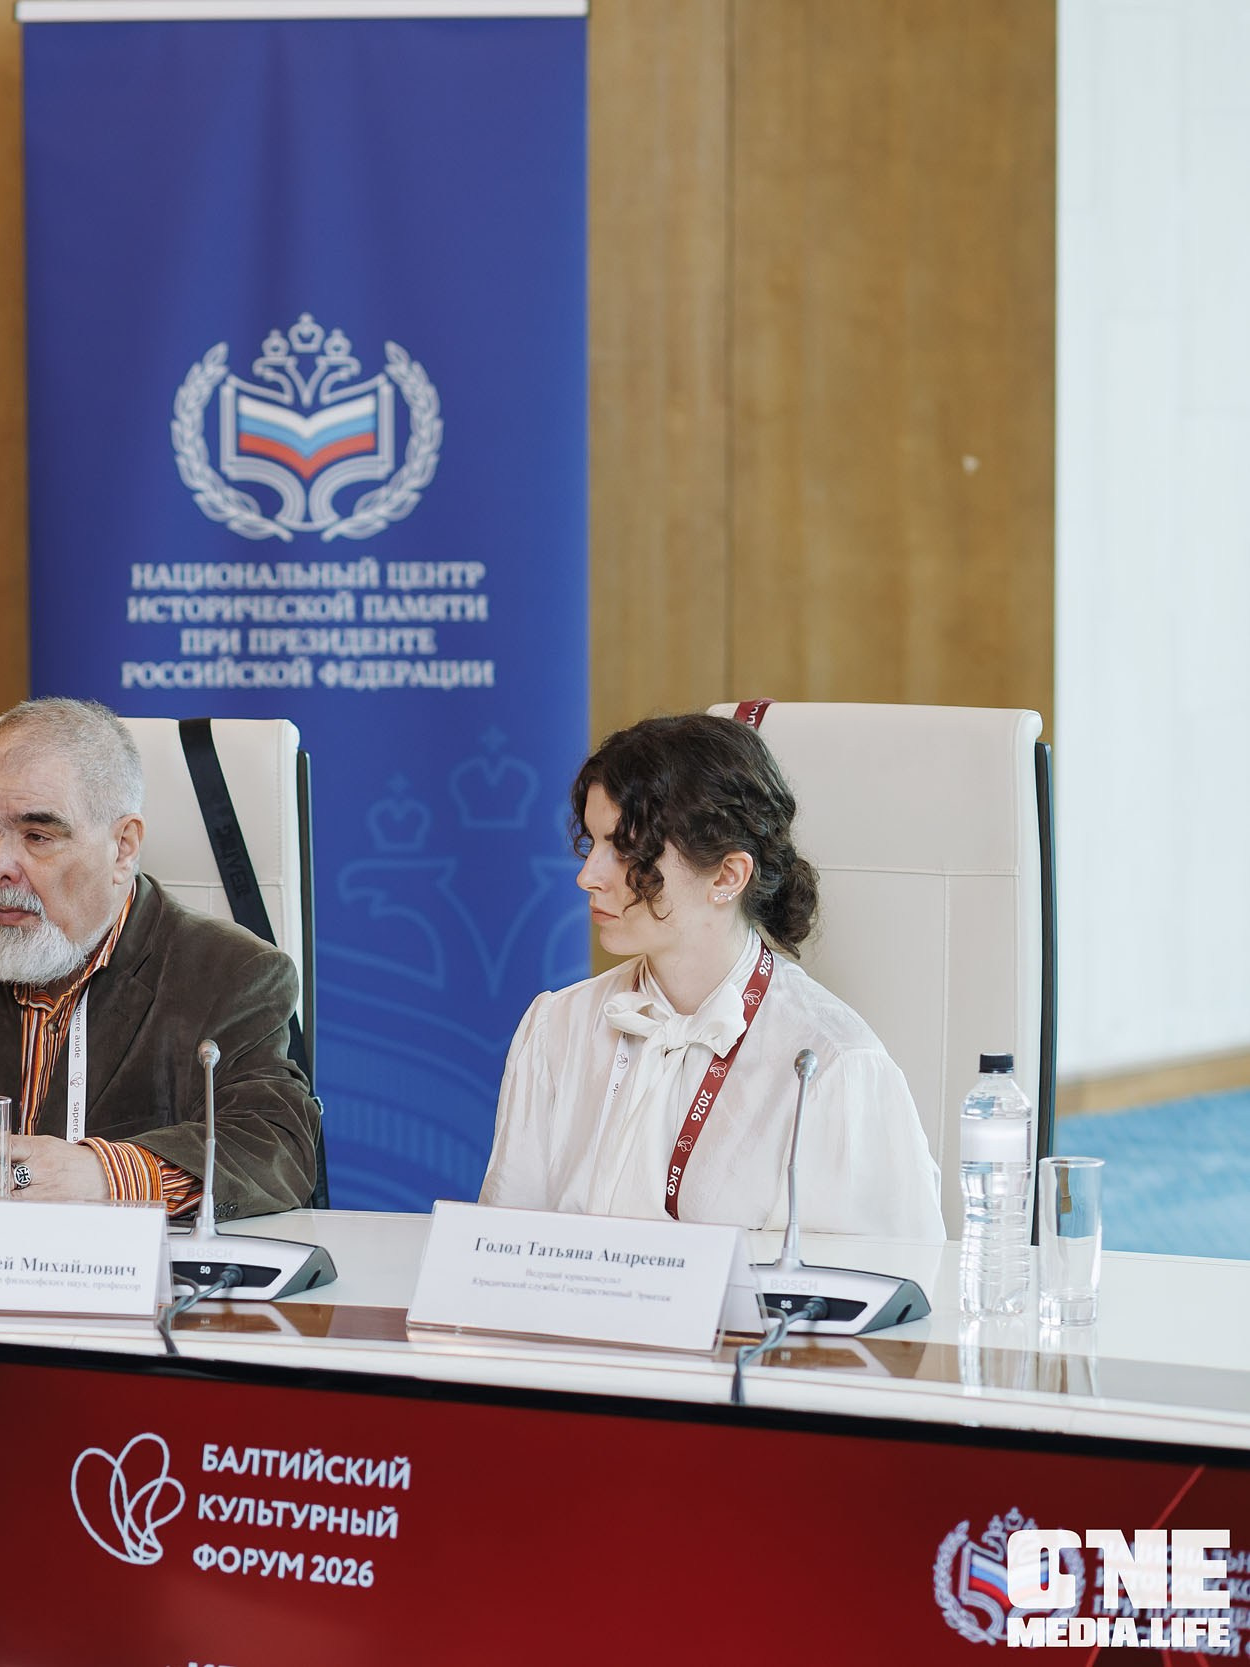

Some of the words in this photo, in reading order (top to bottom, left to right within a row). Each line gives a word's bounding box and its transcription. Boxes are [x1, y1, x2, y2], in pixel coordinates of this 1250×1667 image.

[131, 557, 379, 591] НАЦИОНАЛЬНЫЙ
[387, 561, 486, 591] ЦЕНТР
[127, 591, 355, 623] ИСТОРИЧЕСКОЙ
[362, 594, 488, 622] ПАМЯТИ
[180, 627, 241, 654] ПРИ
[249, 627, 437, 657] ПРЕЗИДЕНТЕ
[121, 656, 313, 689] РОССИЙСКОЙ
[318, 660, 494, 691] ФЕДЕРАЦИИ
[72, 1101, 80, 1134] sapere
[691, 1089, 713, 1122] 2026
[666, 1165, 681, 1197] БКФ
[20, 1257, 137, 1277] Михайлович
[475, 1237, 521, 1256] Голод
[527, 1241, 592, 1261] Татьяна
[598, 1249, 686, 1268] Андреевна
[200, 1265, 211, 1275] 50
[770, 1279, 818, 1291] BOSCH
[202, 1443, 411, 1490] БАЛТИЙСКИЙ
[198, 1493, 398, 1539] КУЛЬТУРНЫЙ
[193, 1543, 304, 1581] ФОРУМ
[309, 1555, 374, 1588] 2026
